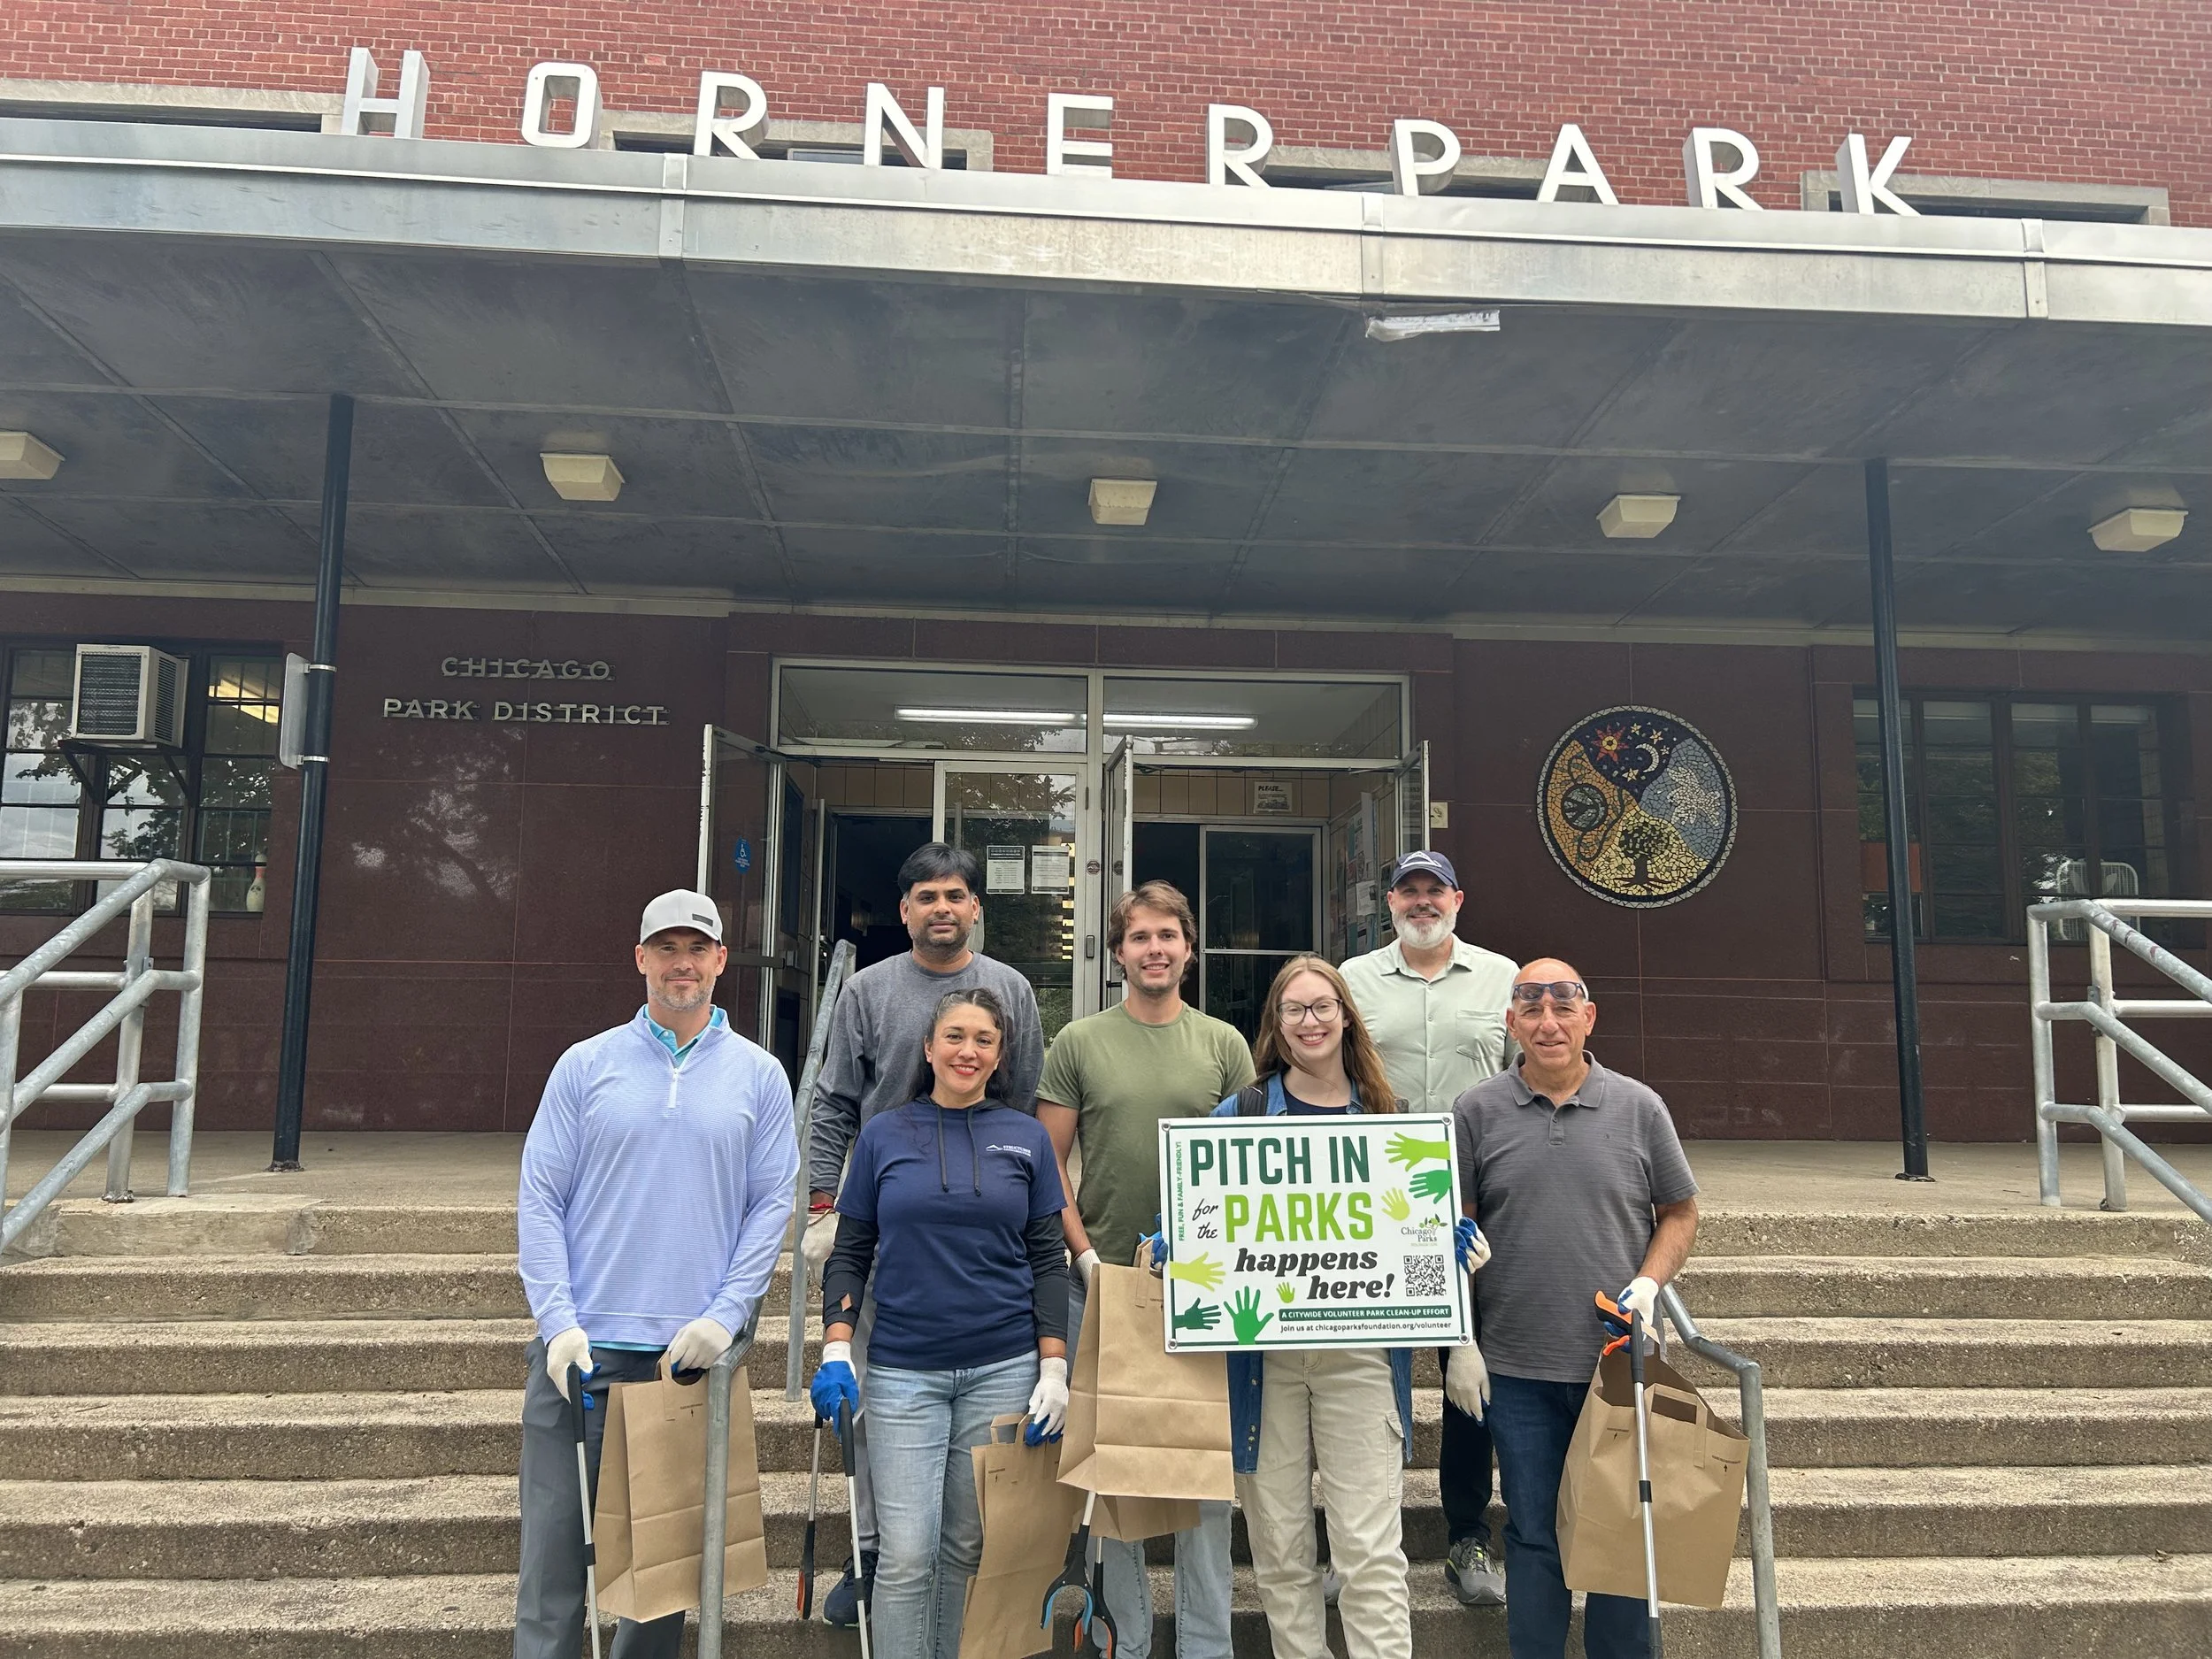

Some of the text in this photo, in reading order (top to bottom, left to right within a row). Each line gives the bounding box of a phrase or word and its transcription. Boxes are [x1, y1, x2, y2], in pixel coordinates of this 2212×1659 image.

[342, 47, 1920, 217] HORNER PARK
[442, 657, 611, 680] CHICAGO
[383, 698, 665, 726] PARK DISTRICT
[1189, 1135, 1371, 1187] PITCH IN
[1192, 1198, 1219, 1221] for
[1225, 1192, 1373, 1242] PARKS
[1197, 1222, 1218, 1240] the
[1401, 1226, 1432, 1237] Chicago
[1233, 1248, 1378, 1278] happens
[1307, 1273, 1395, 1300] here!
[1280, 1325, 1295, 1333] Join
[1315, 1321, 1451, 1333] chicagoparksfoundation.org/volunteer
